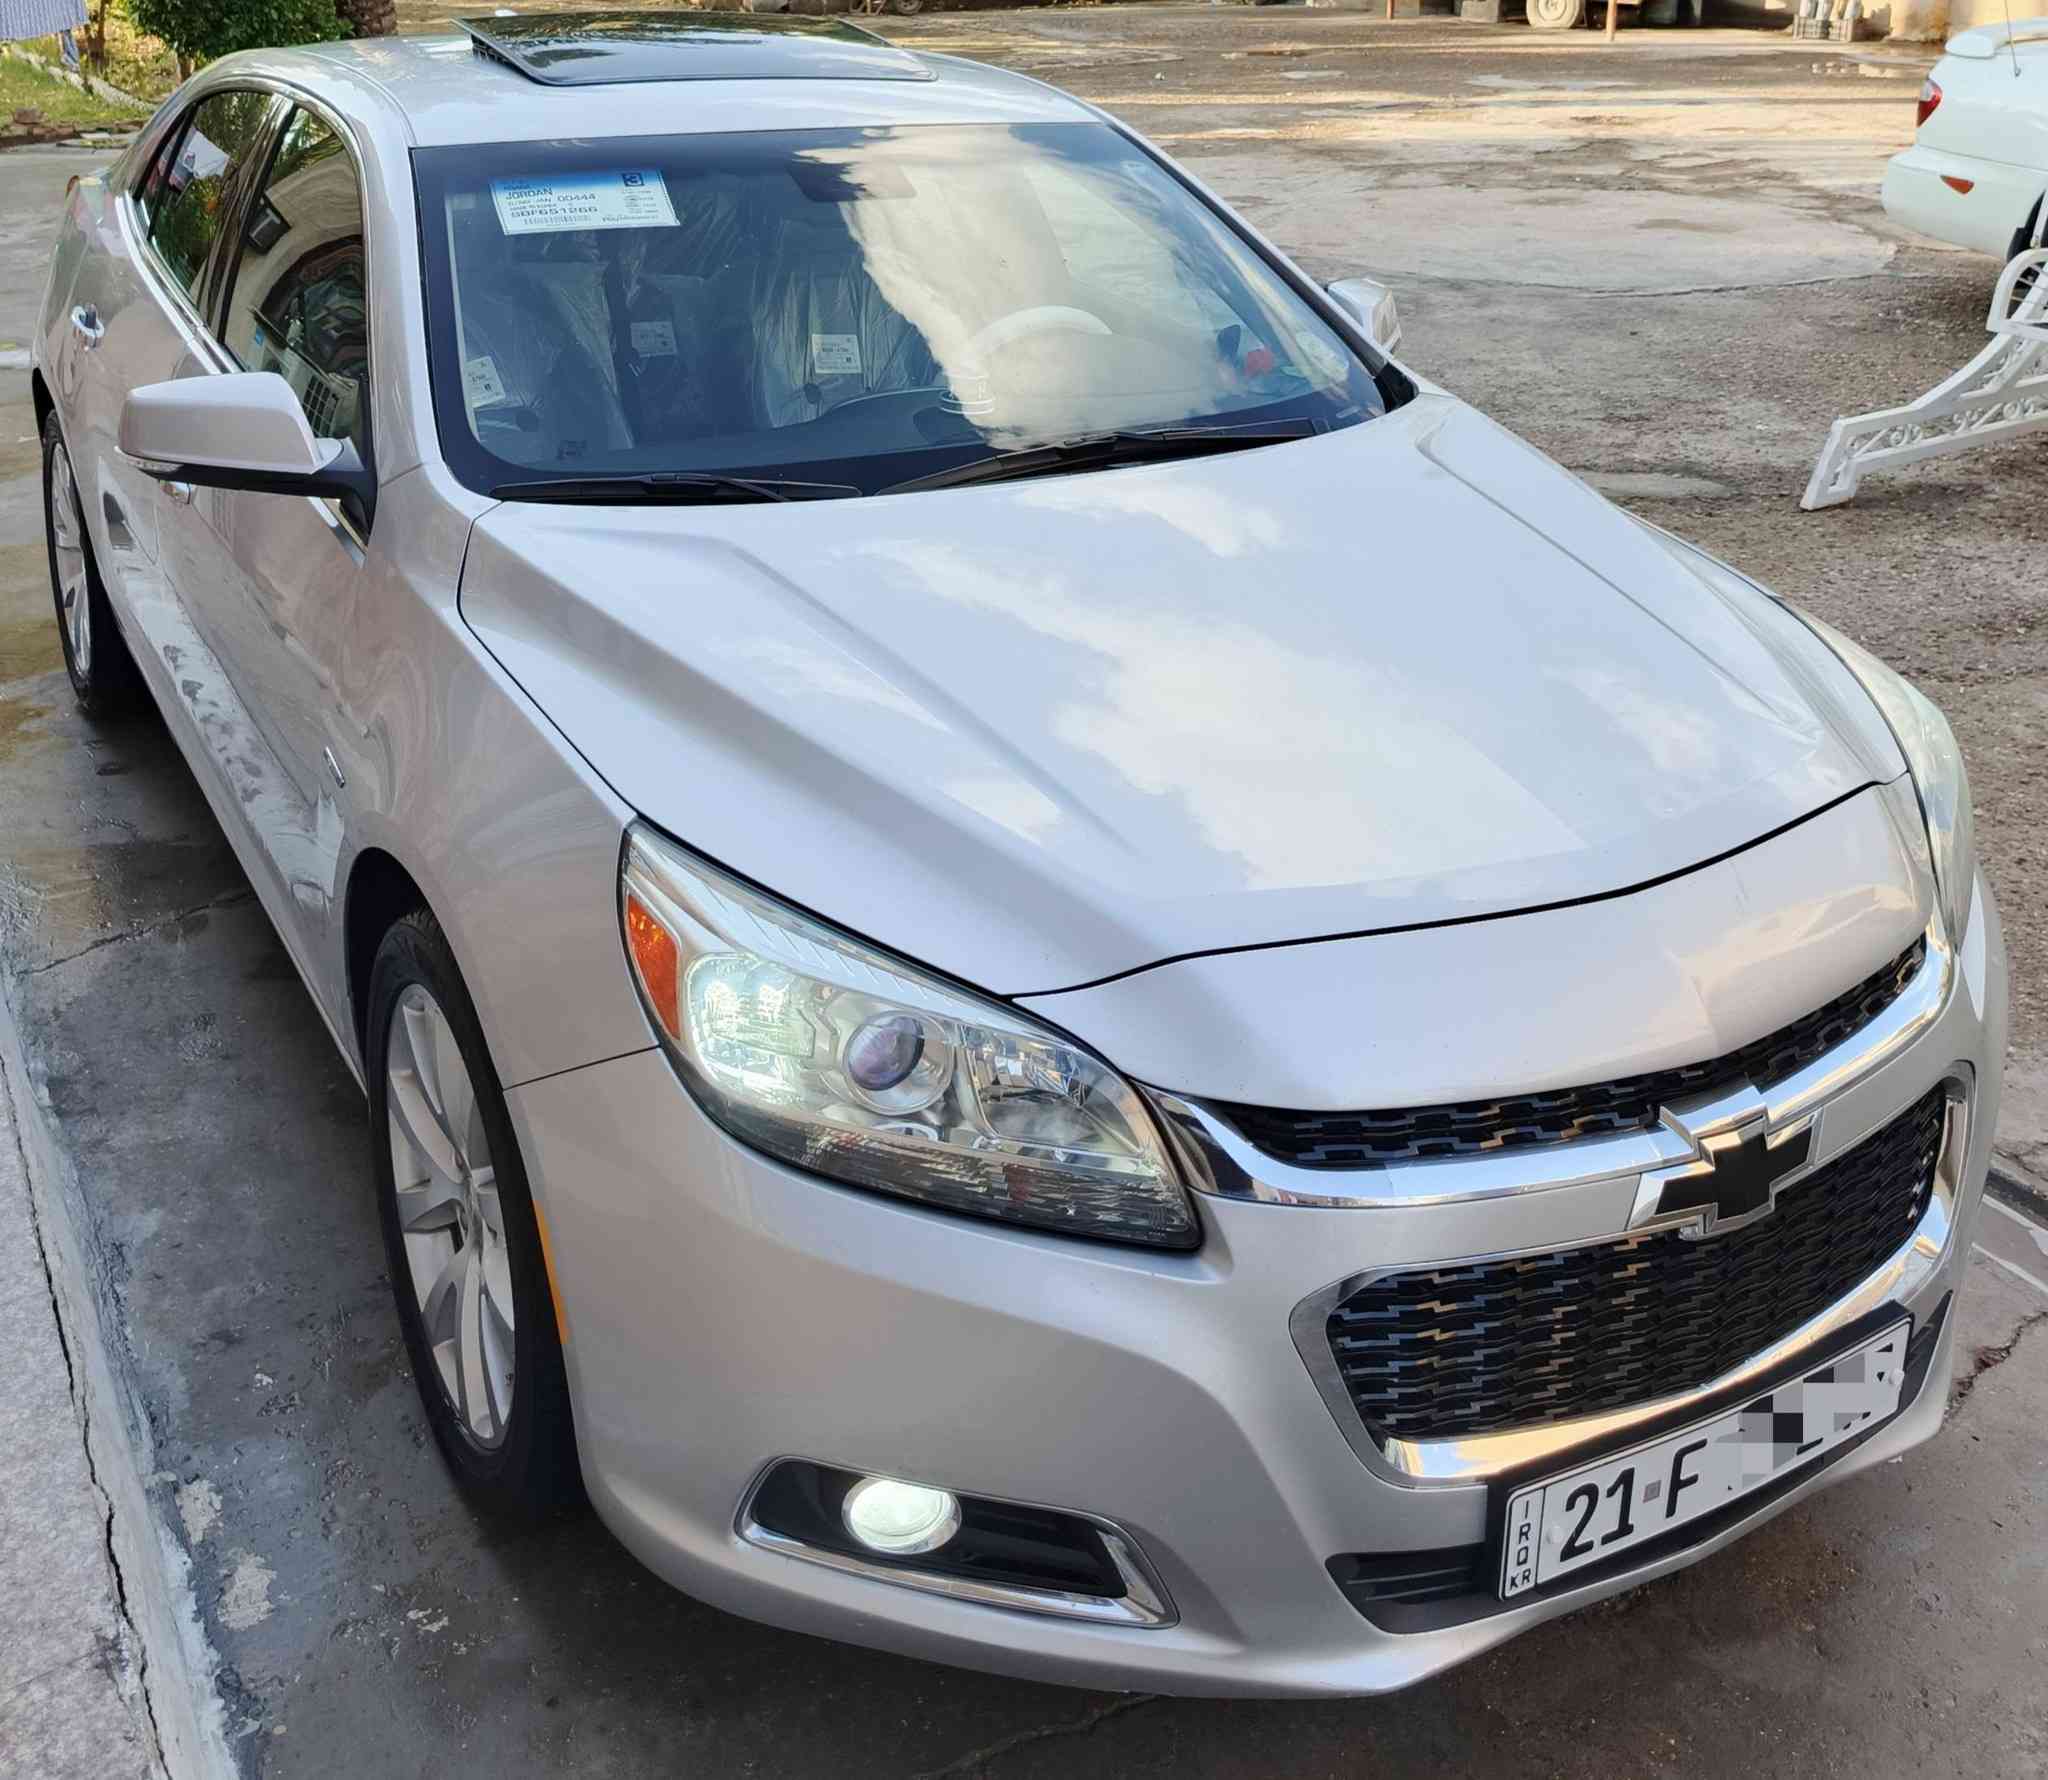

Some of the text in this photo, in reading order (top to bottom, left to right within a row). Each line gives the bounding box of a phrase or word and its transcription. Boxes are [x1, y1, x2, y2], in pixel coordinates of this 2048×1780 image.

[505, 187, 553, 200] JORDAN
[1559, 1438, 1709, 1563] 21 F
[1509, 1568, 1532, 1591] KR
